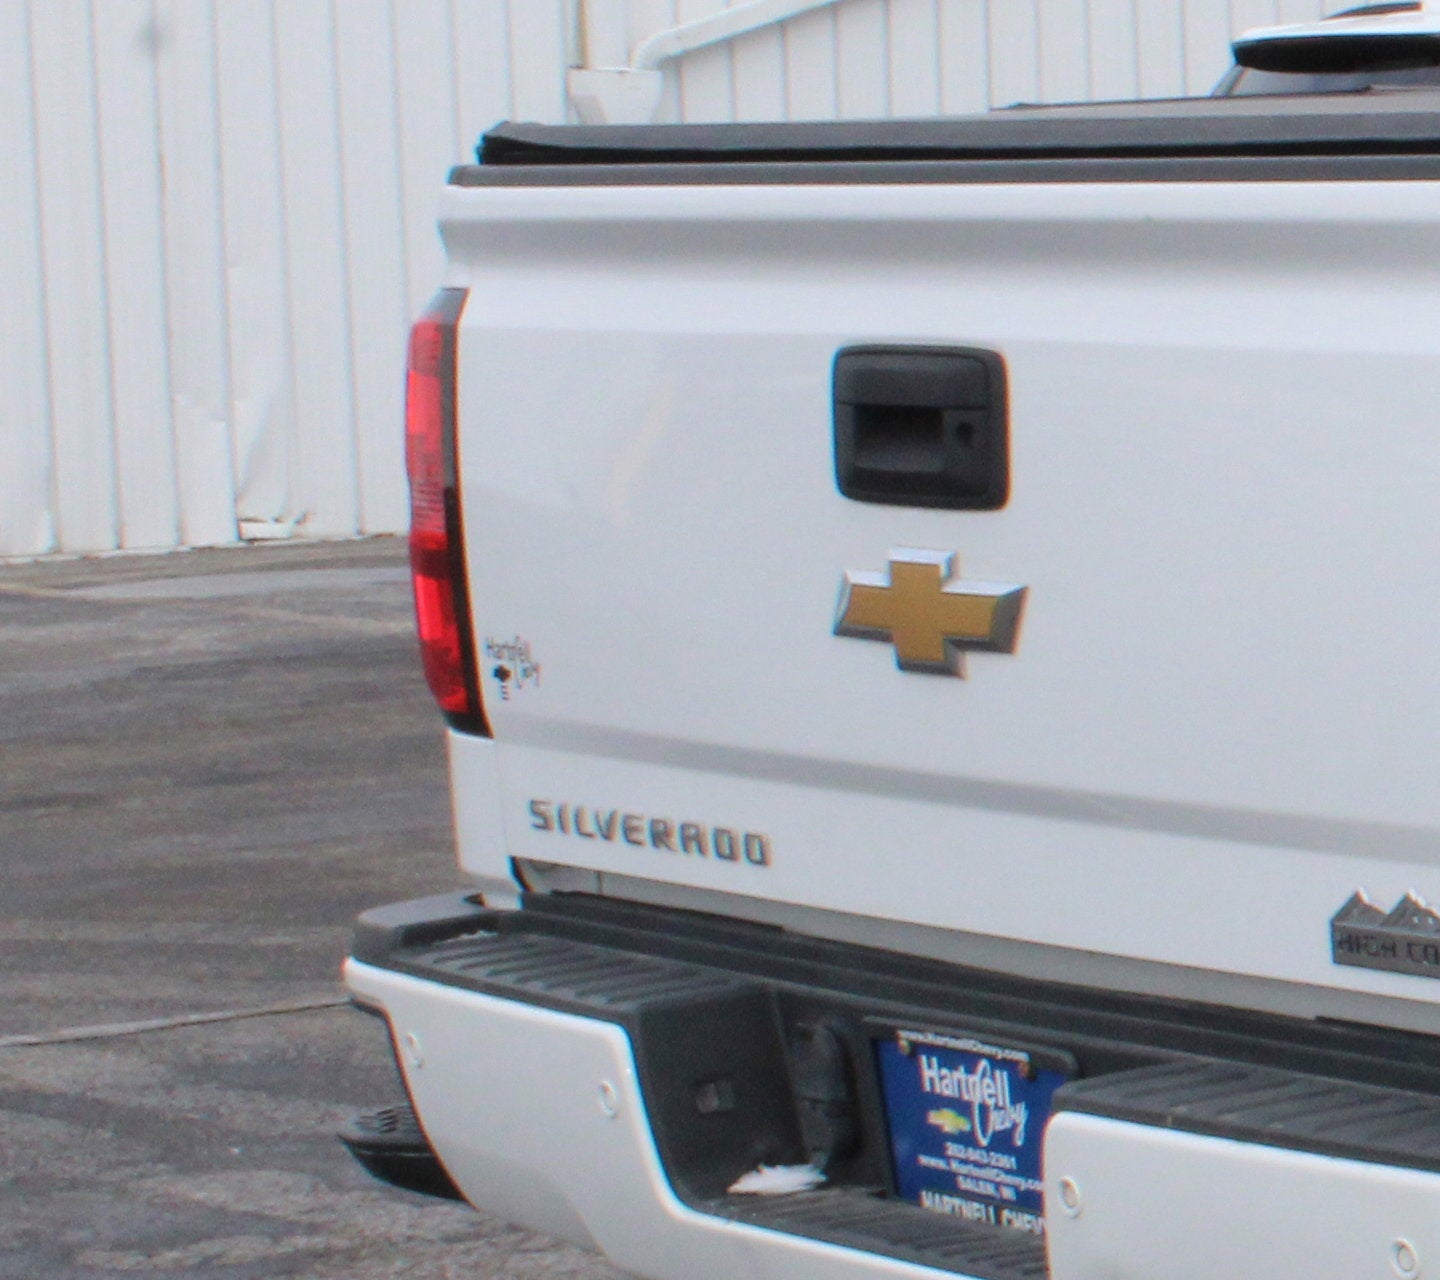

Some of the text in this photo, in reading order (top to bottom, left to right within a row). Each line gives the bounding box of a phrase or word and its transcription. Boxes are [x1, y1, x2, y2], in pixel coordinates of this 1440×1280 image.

[529, 799, 776, 867] SILVERADO
[1337, 932, 1398, 960] HIGH
[918, 1053, 1011, 1108] Hartnell
